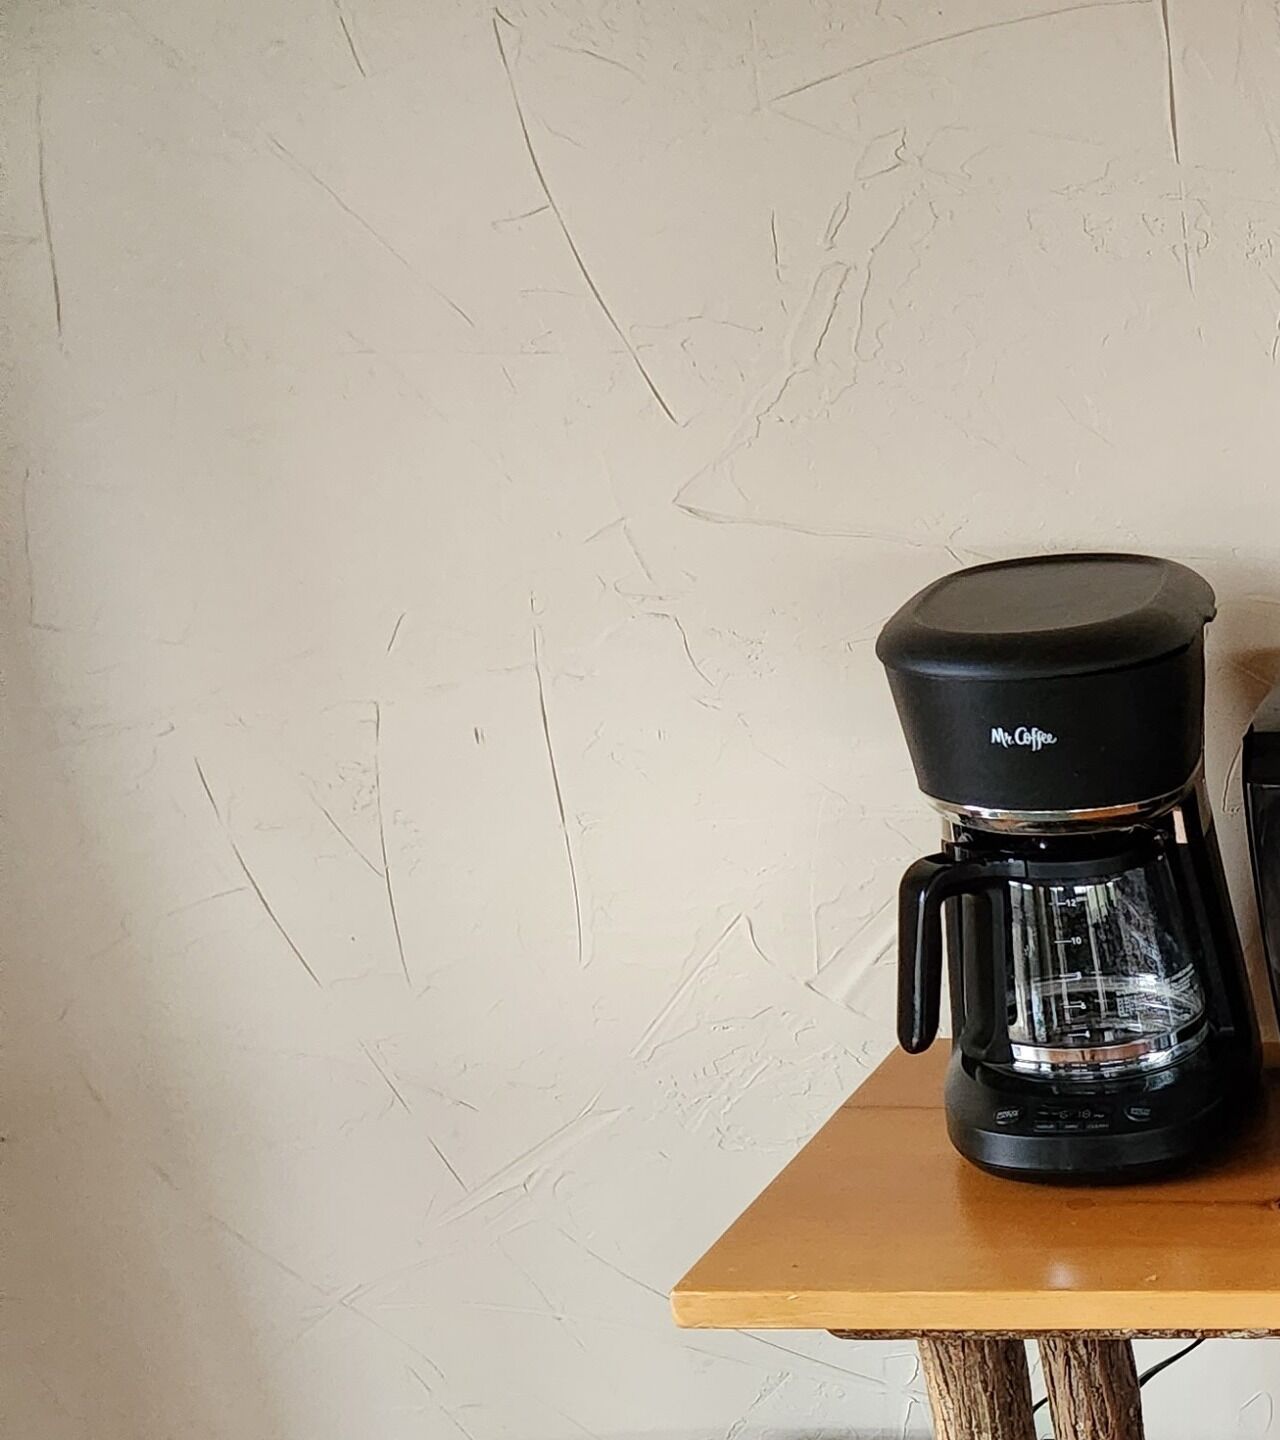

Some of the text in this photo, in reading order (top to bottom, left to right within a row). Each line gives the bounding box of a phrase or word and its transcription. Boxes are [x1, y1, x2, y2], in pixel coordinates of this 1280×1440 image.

[991, 726, 1058, 752] Mr. Coffee
[1070, 936, 1082, 945] 10
